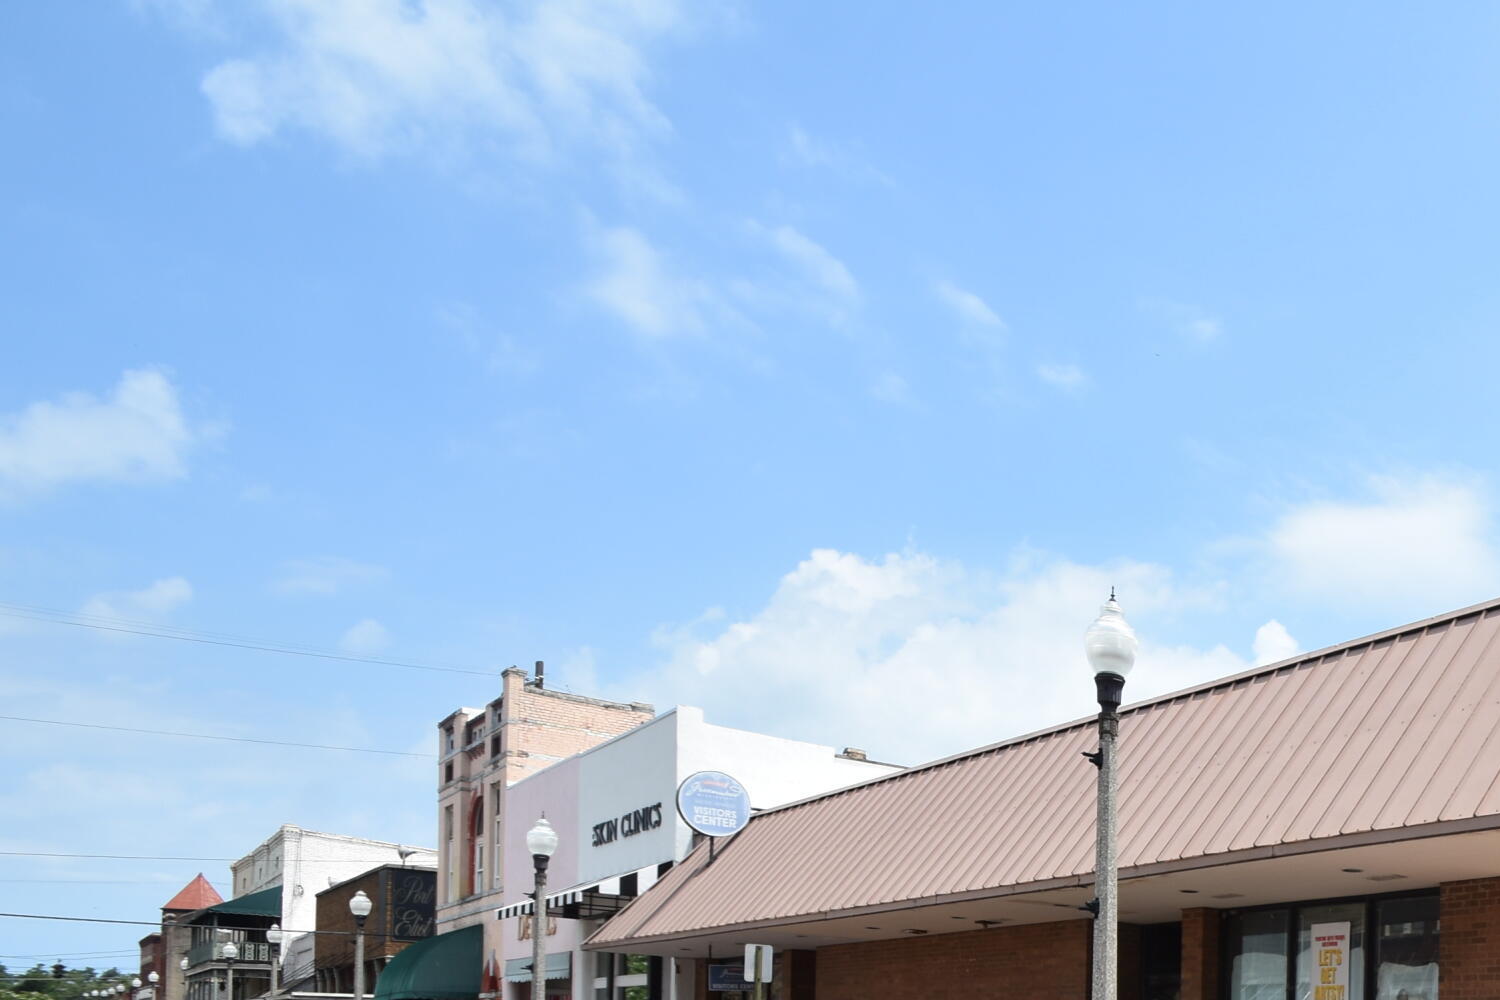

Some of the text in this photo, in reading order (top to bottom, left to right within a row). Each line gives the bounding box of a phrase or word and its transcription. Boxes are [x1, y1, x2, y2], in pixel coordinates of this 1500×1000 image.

[694, 806, 737, 818] VISITORS
[592, 802, 662, 847] SKIN CLINICS
[694, 814, 737, 828] CENTER
[1319, 949, 1342, 966] LET'S
